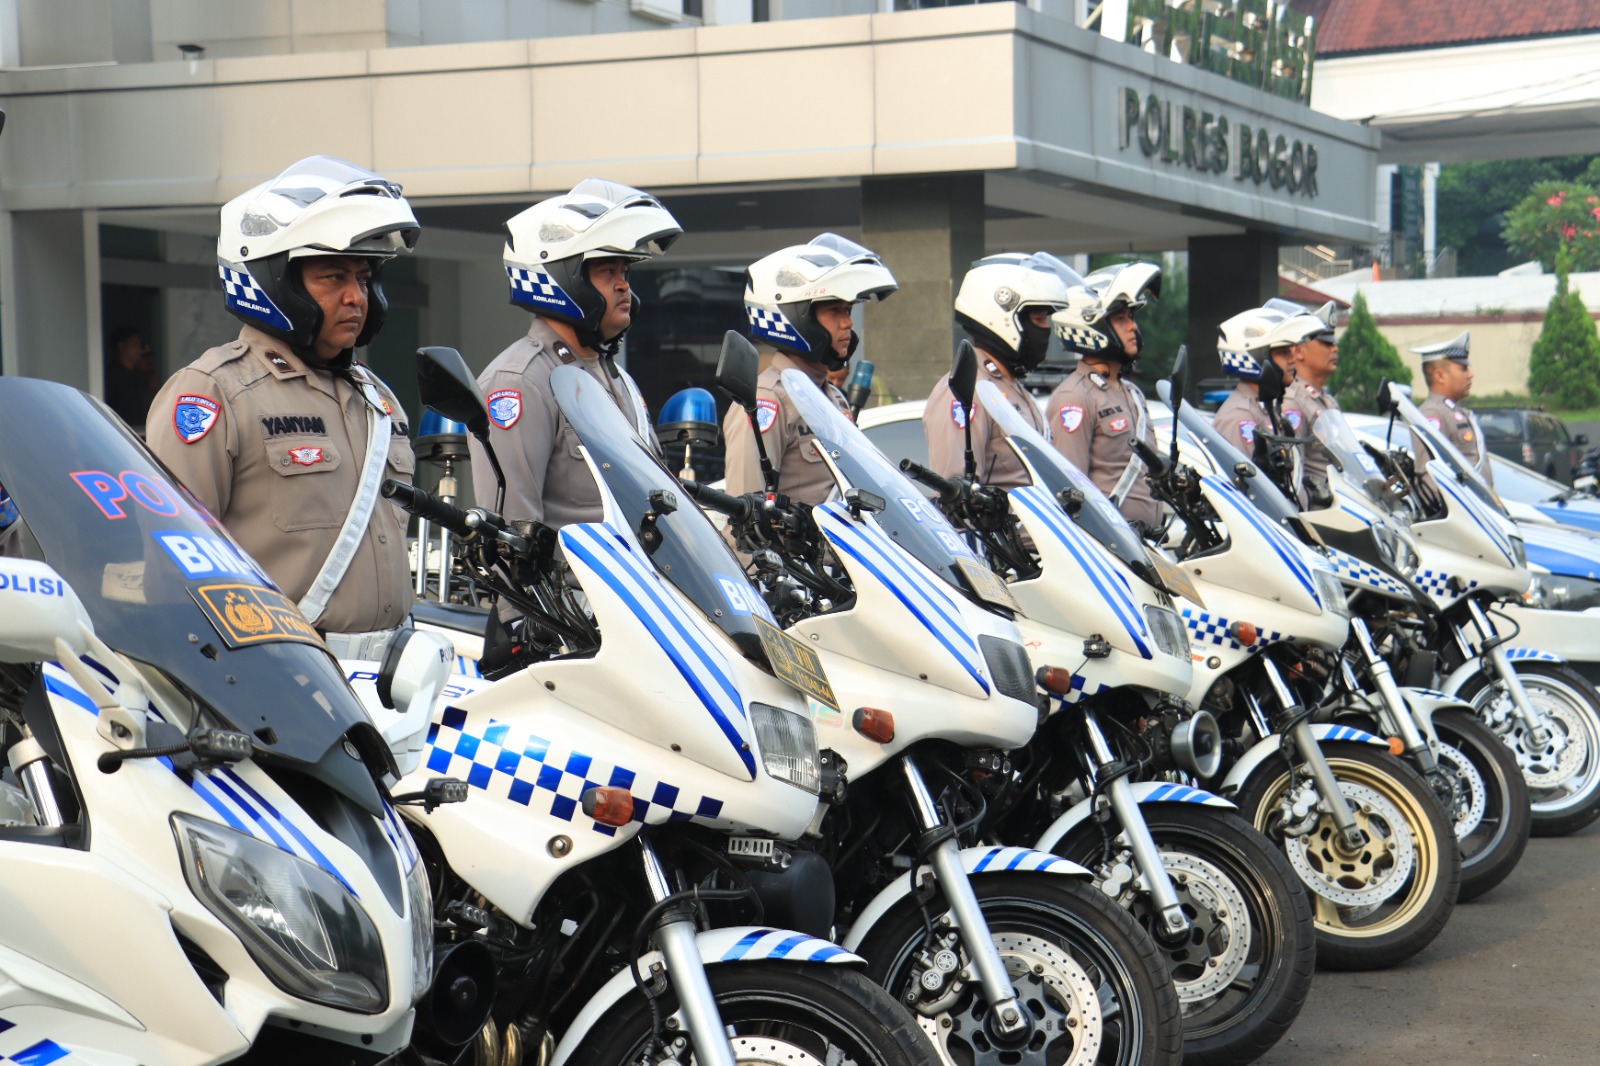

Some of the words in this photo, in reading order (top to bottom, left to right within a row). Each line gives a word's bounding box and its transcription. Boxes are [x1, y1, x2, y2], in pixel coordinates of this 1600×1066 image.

[1118, 86, 1230, 175] POLRES
[1232, 122, 1329, 199] BOGOR
[261, 415, 326, 436] YANYAN
[0, 572, 64, 598] OLISI
